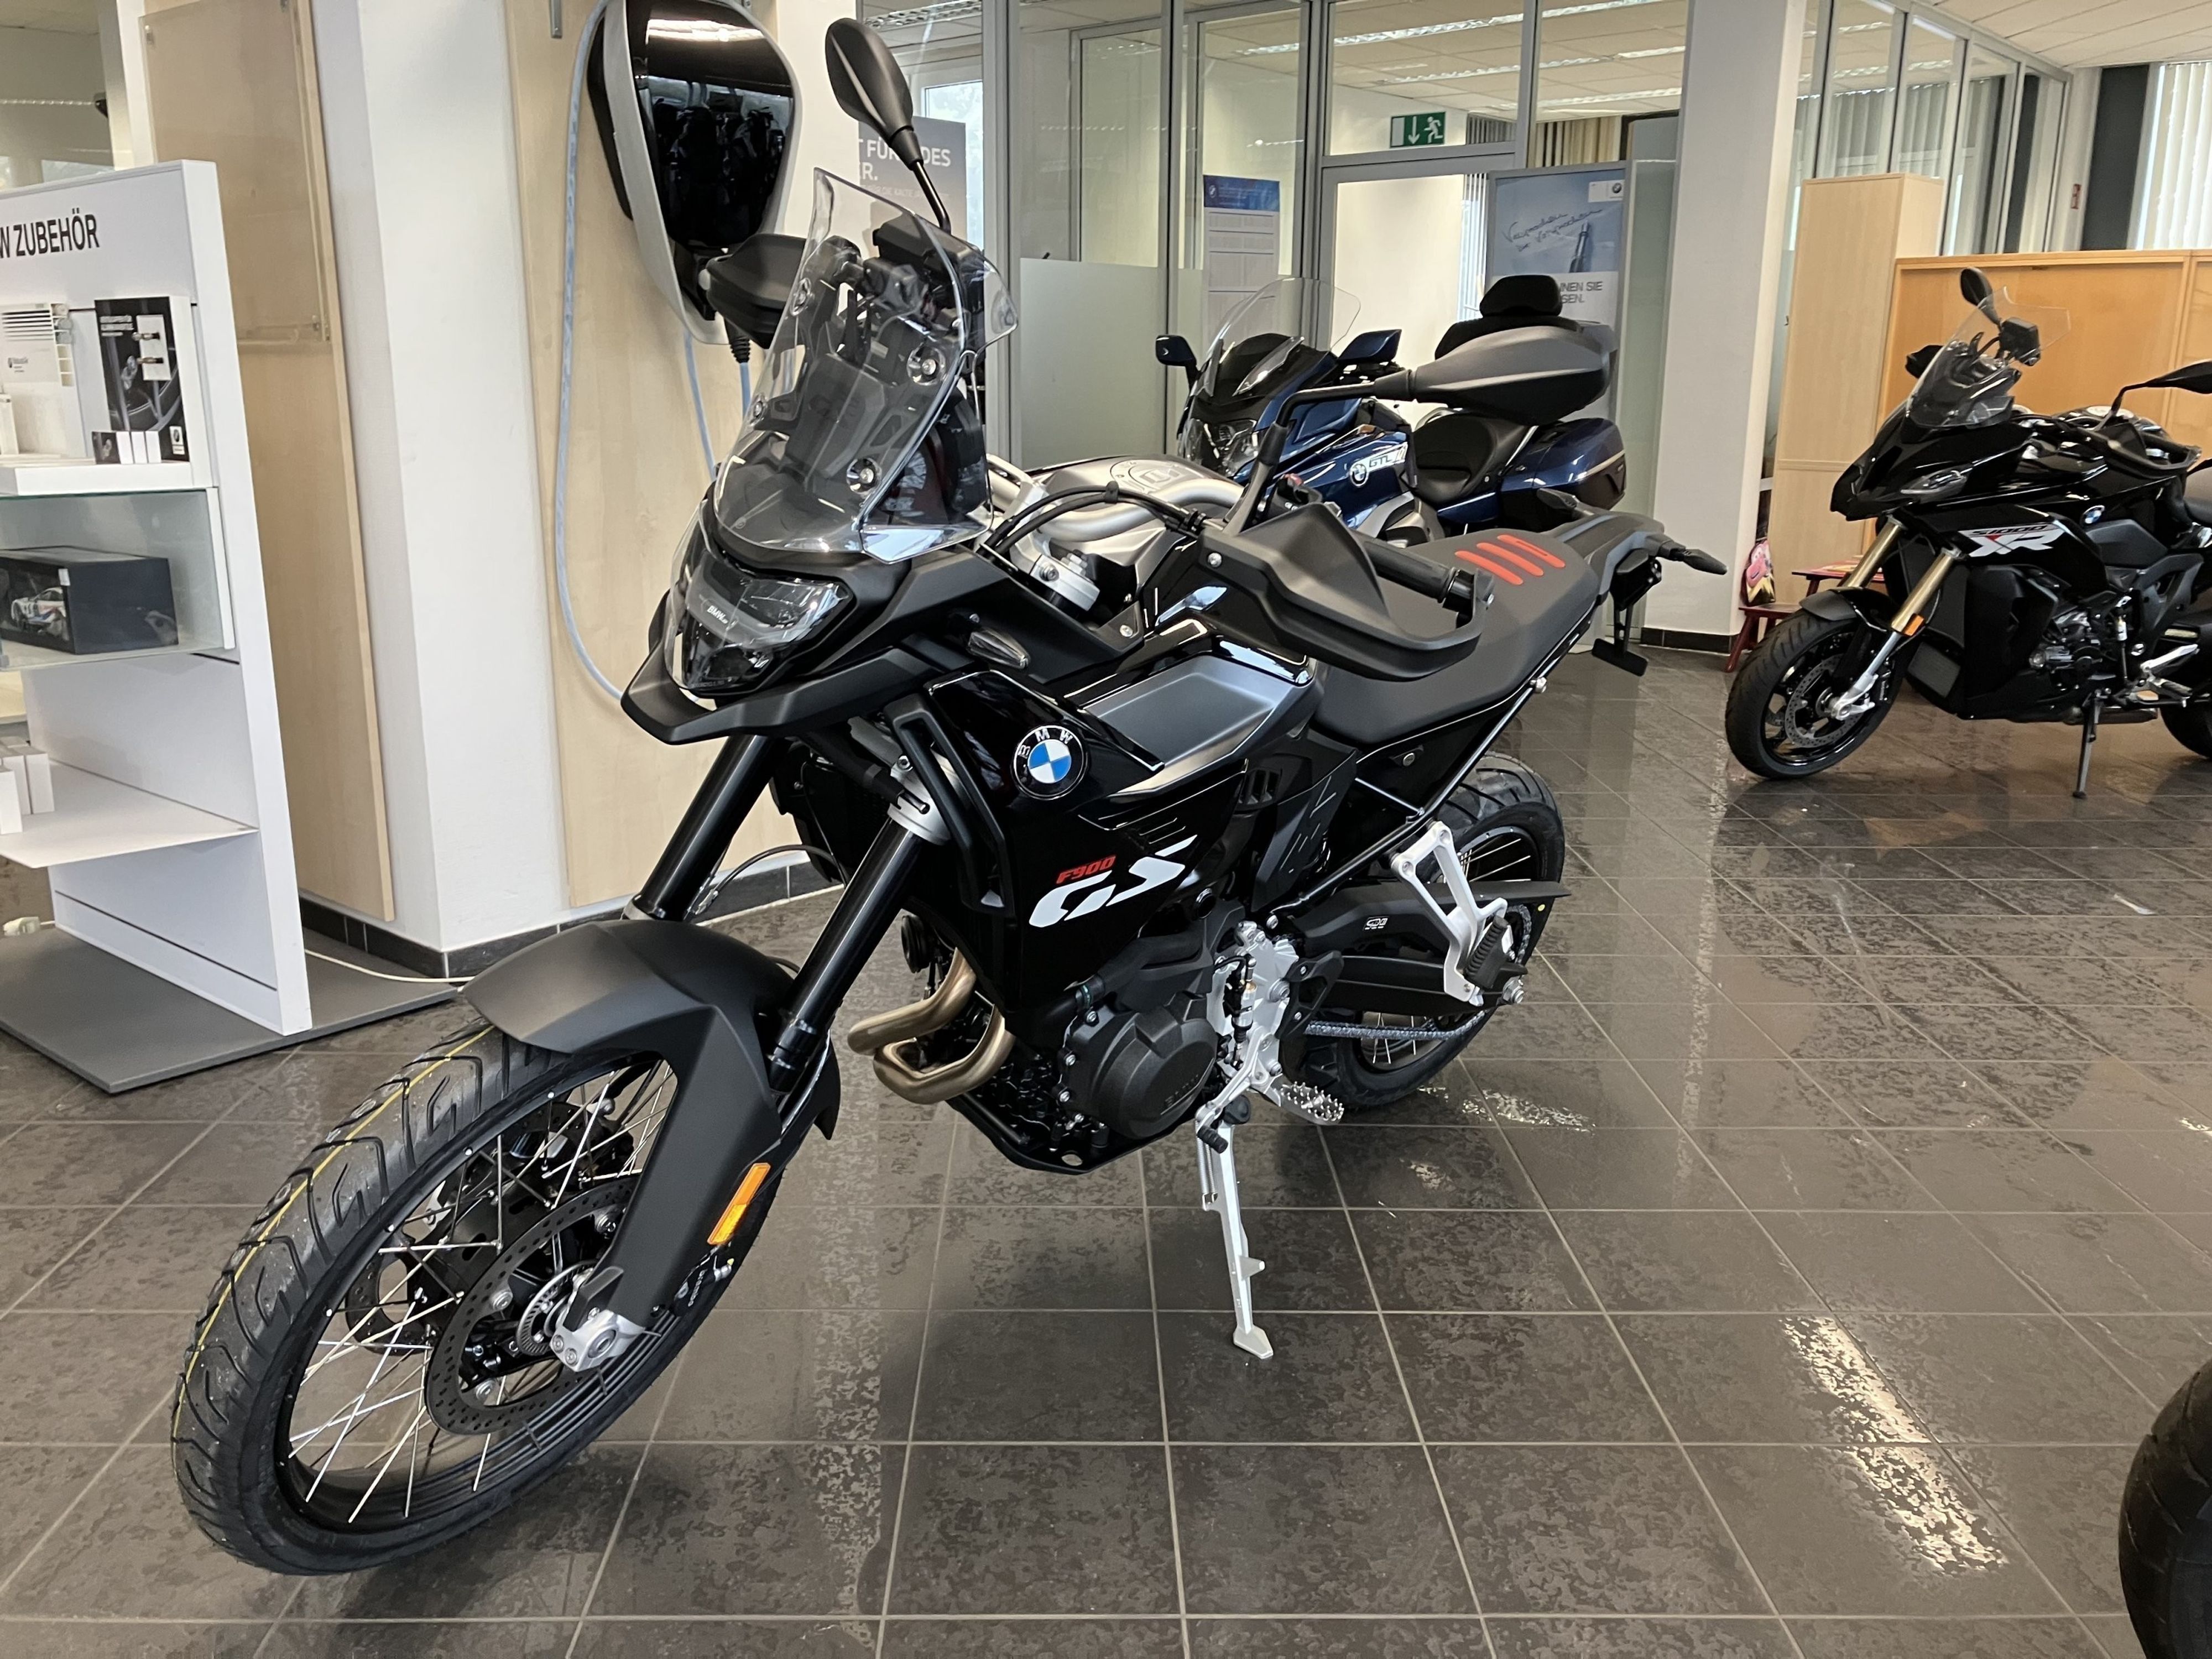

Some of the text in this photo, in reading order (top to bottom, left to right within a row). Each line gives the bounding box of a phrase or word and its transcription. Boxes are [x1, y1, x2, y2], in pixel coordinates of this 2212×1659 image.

[920, 146, 951, 167] DES
[13, 207, 100, 257] ZUBEHÖR
[1586, 281, 1603, 291] SIE
[1561, 294, 1585, 304] SEN.
[1369, 455, 1392, 468] GTL
[1968, 529, 2066, 558] XR
[707, 605, 727, 620] BMW
[1018, 728, 1073, 759] BMW
[1028, 834, 1198, 928] GS
[1056, 855, 1117, 884] F900
